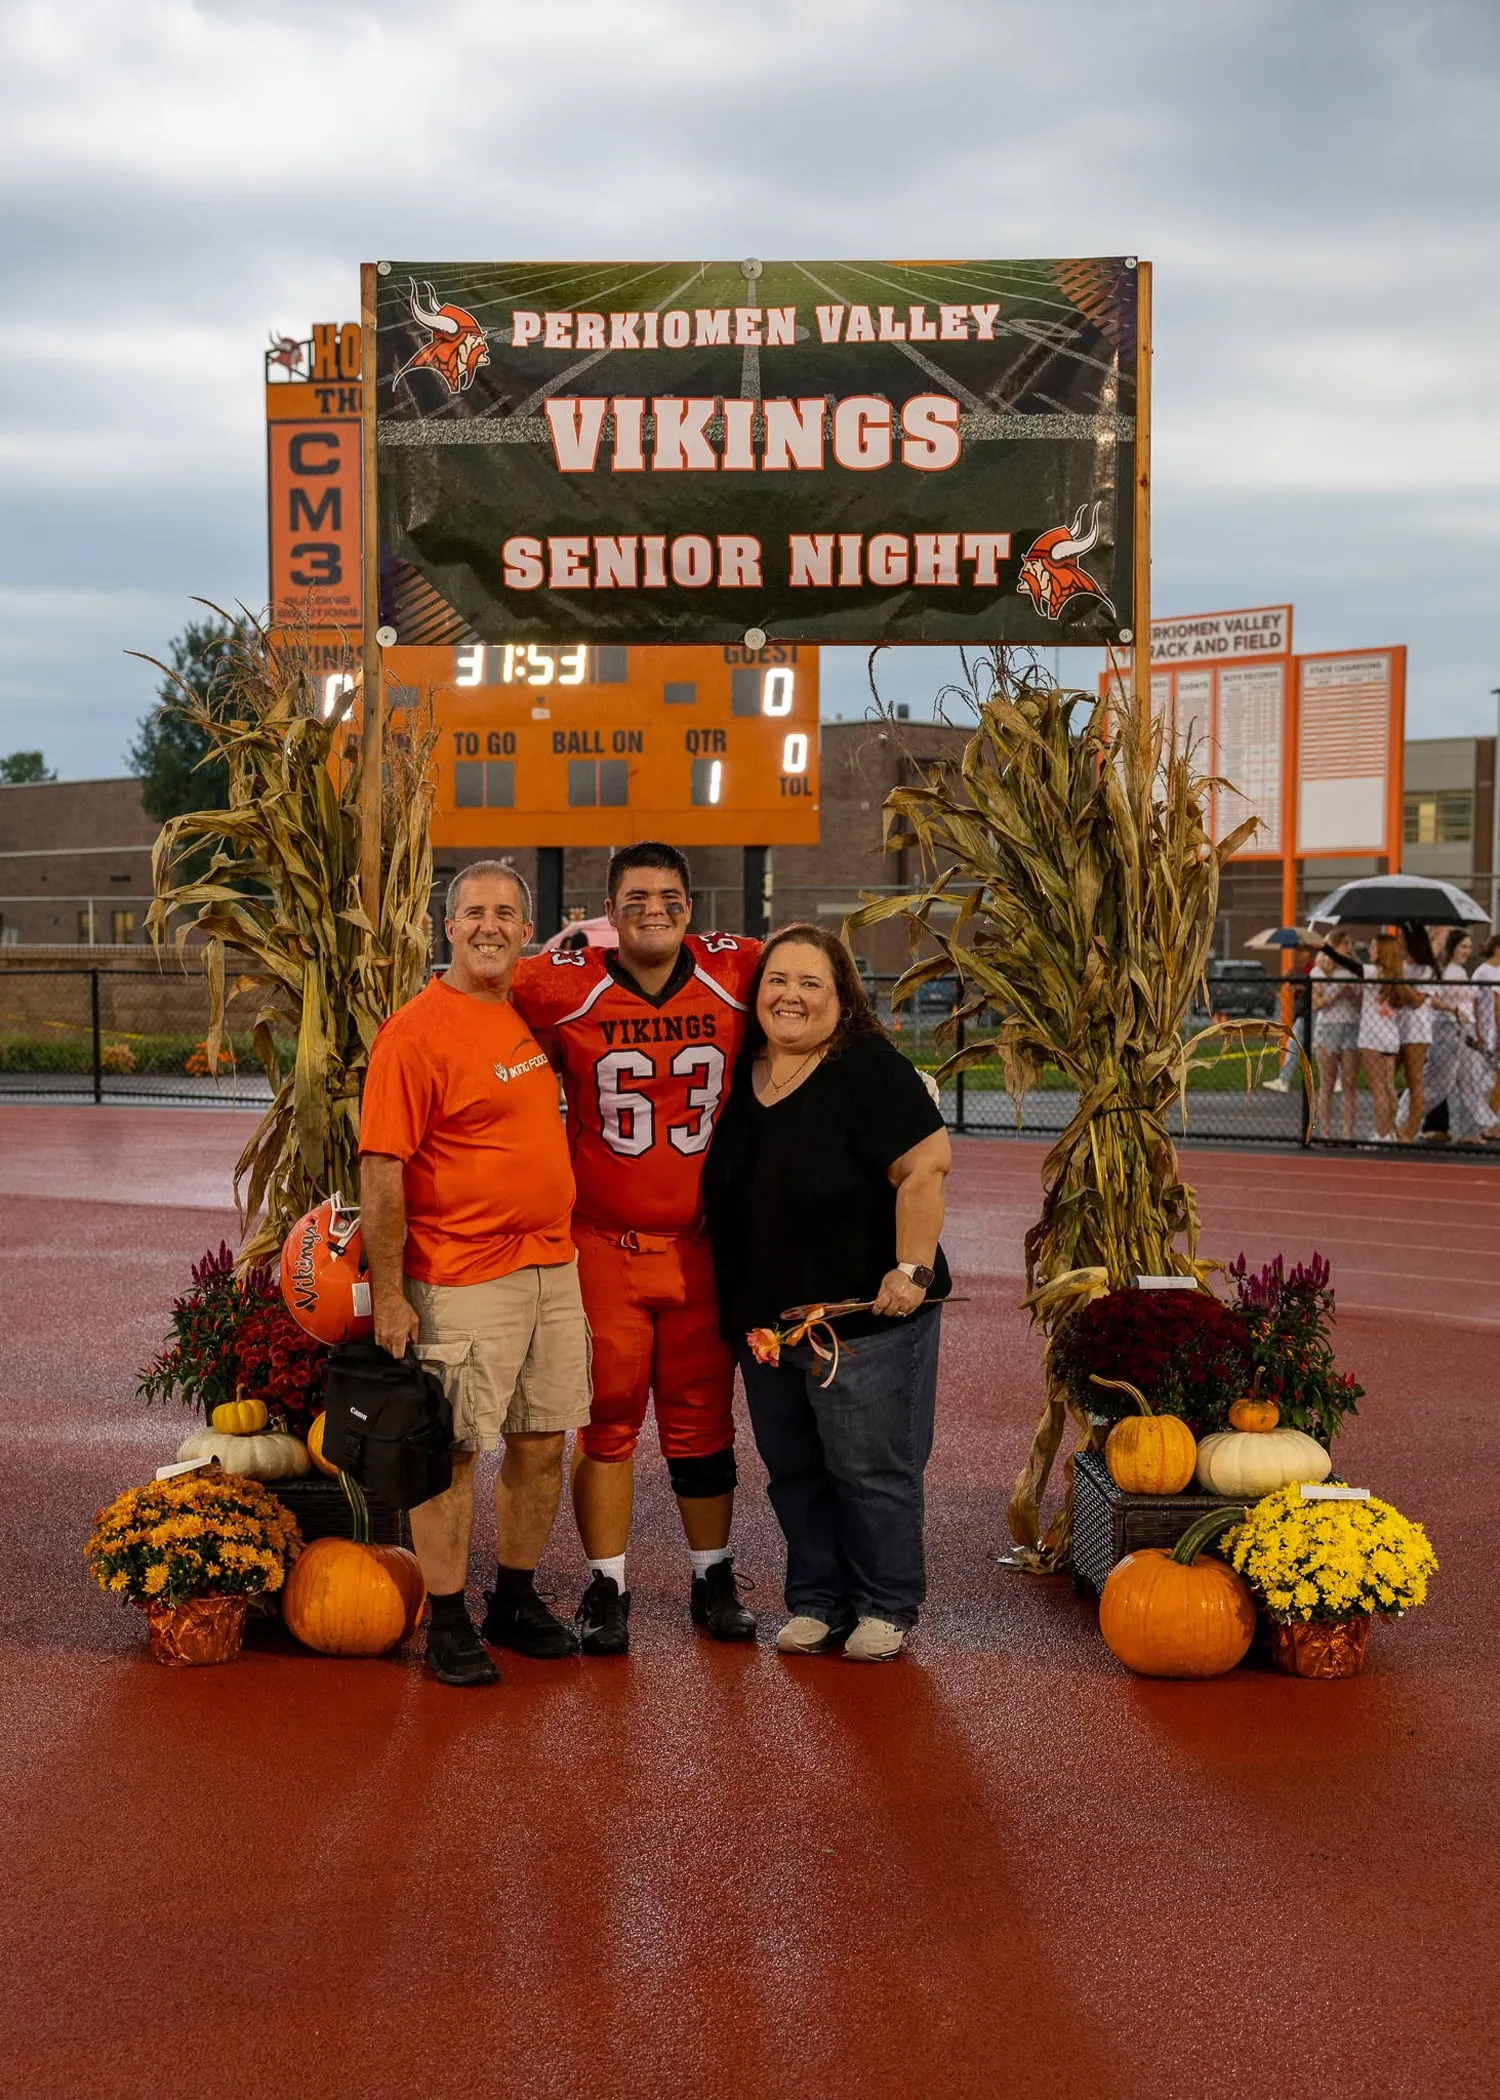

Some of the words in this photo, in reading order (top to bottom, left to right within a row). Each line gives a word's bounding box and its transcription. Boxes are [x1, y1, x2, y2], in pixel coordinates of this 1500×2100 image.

[511, 307, 796, 349] PERKIOMEN
[815, 303, 999, 344] VALLEY
[314, 388, 361, 414] TH
[545, 395, 962, 473] VIKINGS
[502, 534, 763, 591] SENIOR
[788, 532, 1011, 587] NIGHT
[1152, 621, 1219, 640] RKIOMEN
[1225, 613, 1282, 632] VALLEY
[724, 646, 799, 664] GUEST
[1193, 638, 1228, 655] AND
[1233, 632, 1281, 651] FIELD
[763, 667, 794, 717] 0
[454, 732, 479, 755] TO
[488, 731, 516, 755] GO
[553, 731, 604, 754] BALL
[613, 730, 644, 754] ON
[686, 729, 727, 756] QTR
[783, 733, 807, 773] 0
[709, 760, 722, 804] 1
[780, 777, 812, 796] TOL
[600, 1014, 717, 1045] VIKINGS
[594, 1042, 726, 1157] 63
[292, 1225, 322, 1309] Vikings
[350, 1406, 367, 1421] Canon
